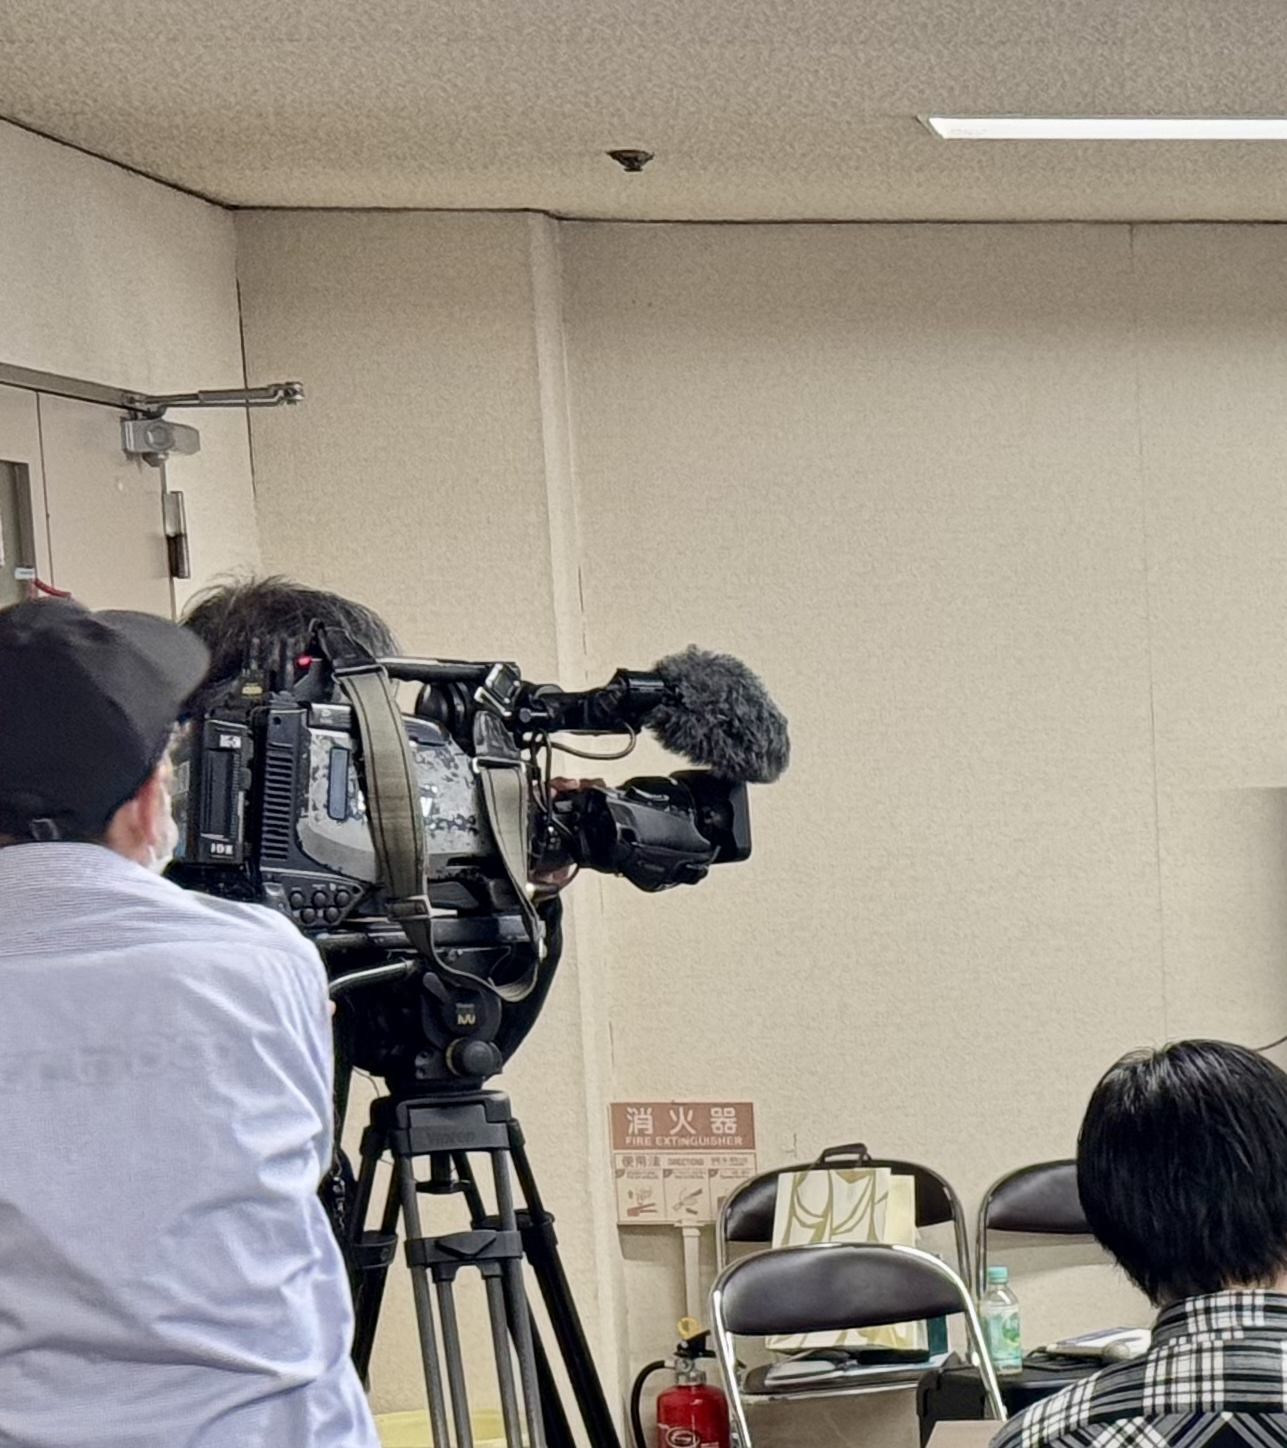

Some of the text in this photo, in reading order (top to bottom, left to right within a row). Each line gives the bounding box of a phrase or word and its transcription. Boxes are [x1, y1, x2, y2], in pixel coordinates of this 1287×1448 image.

[626, 1106, 737, 1135] 消火器
[625, 1136, 743, 1146] FIRE EXTINGUISHER
